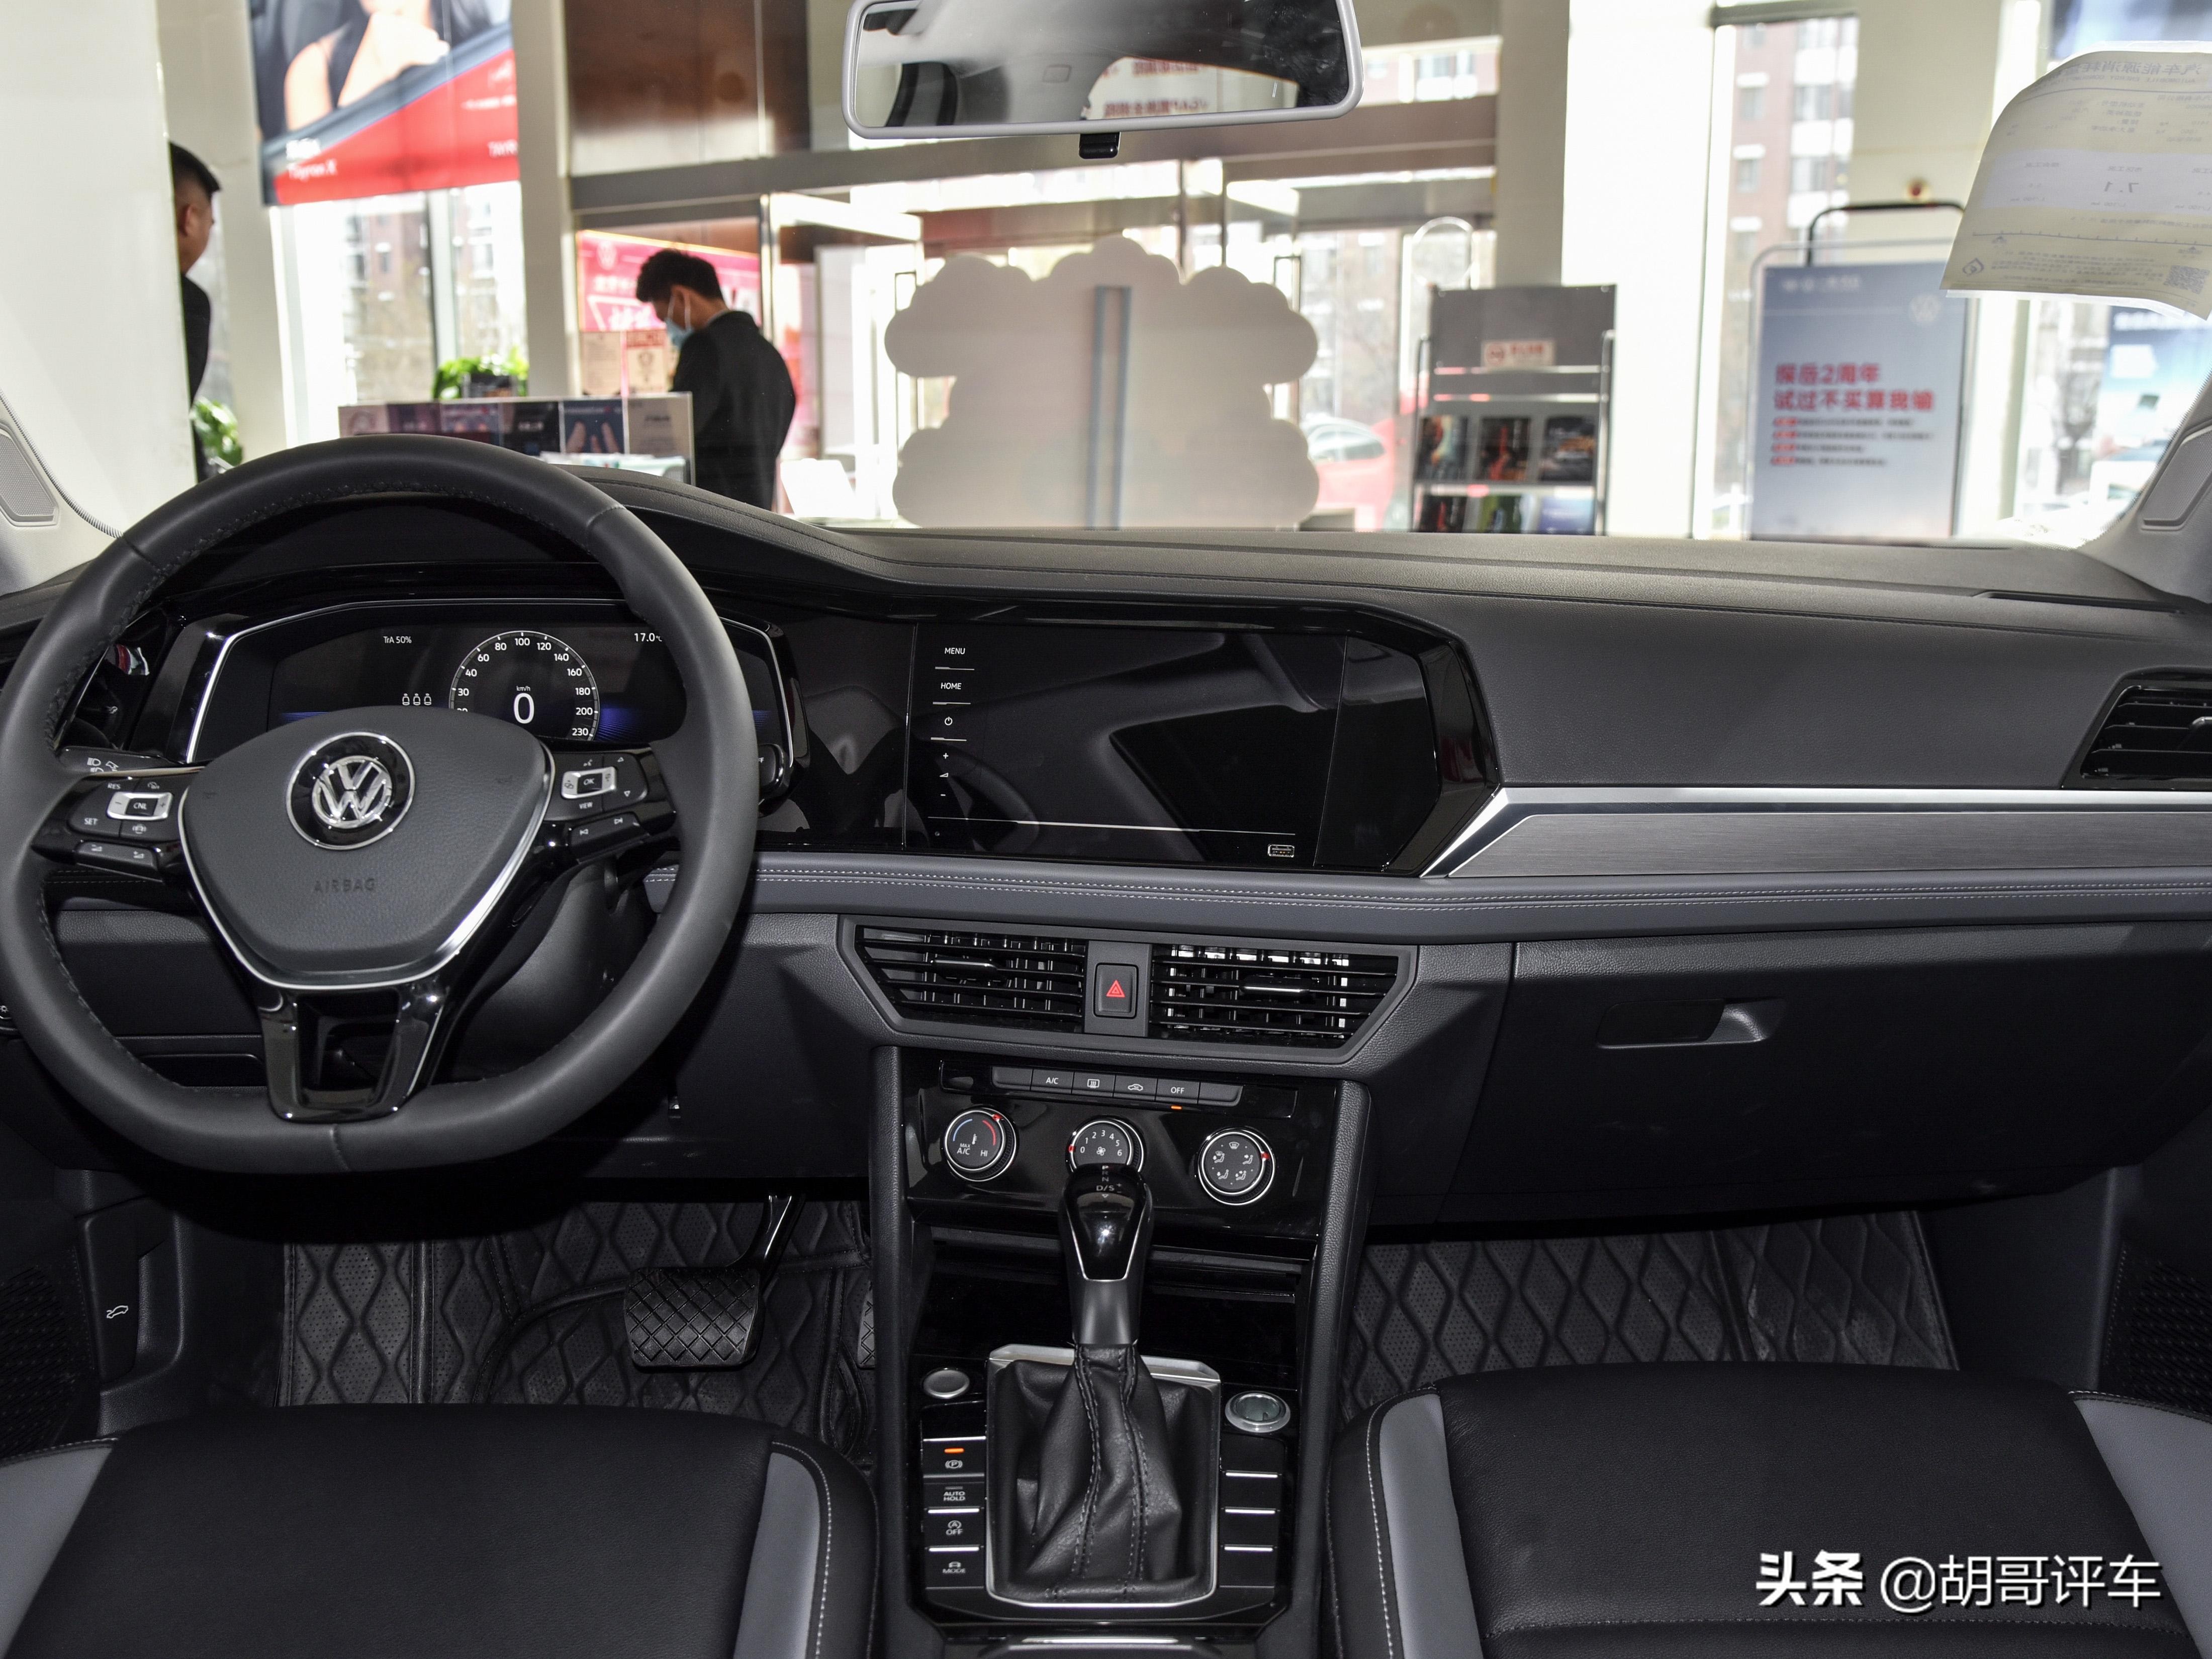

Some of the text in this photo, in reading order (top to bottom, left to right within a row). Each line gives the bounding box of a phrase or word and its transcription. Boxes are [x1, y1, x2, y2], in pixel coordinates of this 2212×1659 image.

[383, 635, 412, 643] TrA 50%
[514, 637, 530, 646] 100
[494, 642, 507, 651] 80
[536, 642, 551, 651] 120
[945, 647, 966, 655] MENU
[478, 654, 490, 662] 60
[554, 653, 569, 662] 140
[465, 669, 478, 677] 40
[567, 668, 582, 677] 160
[941, 682, 962, 690] HOME
[457, 688, 470, 696] 30
[575, 687, 591, 696] 180
[513, 692, 534, 724] 0
[576, 707, 593, 715] 200
[572, 727, 589, 736] 230
[583, 778, 595, 786] OK
[579, 801, 593, 809] VIEW
[84, 817, 98, 825] SET
[314, 877, 375, 893] AIRBAG
[956, 1147, 971, 1155] A/C
